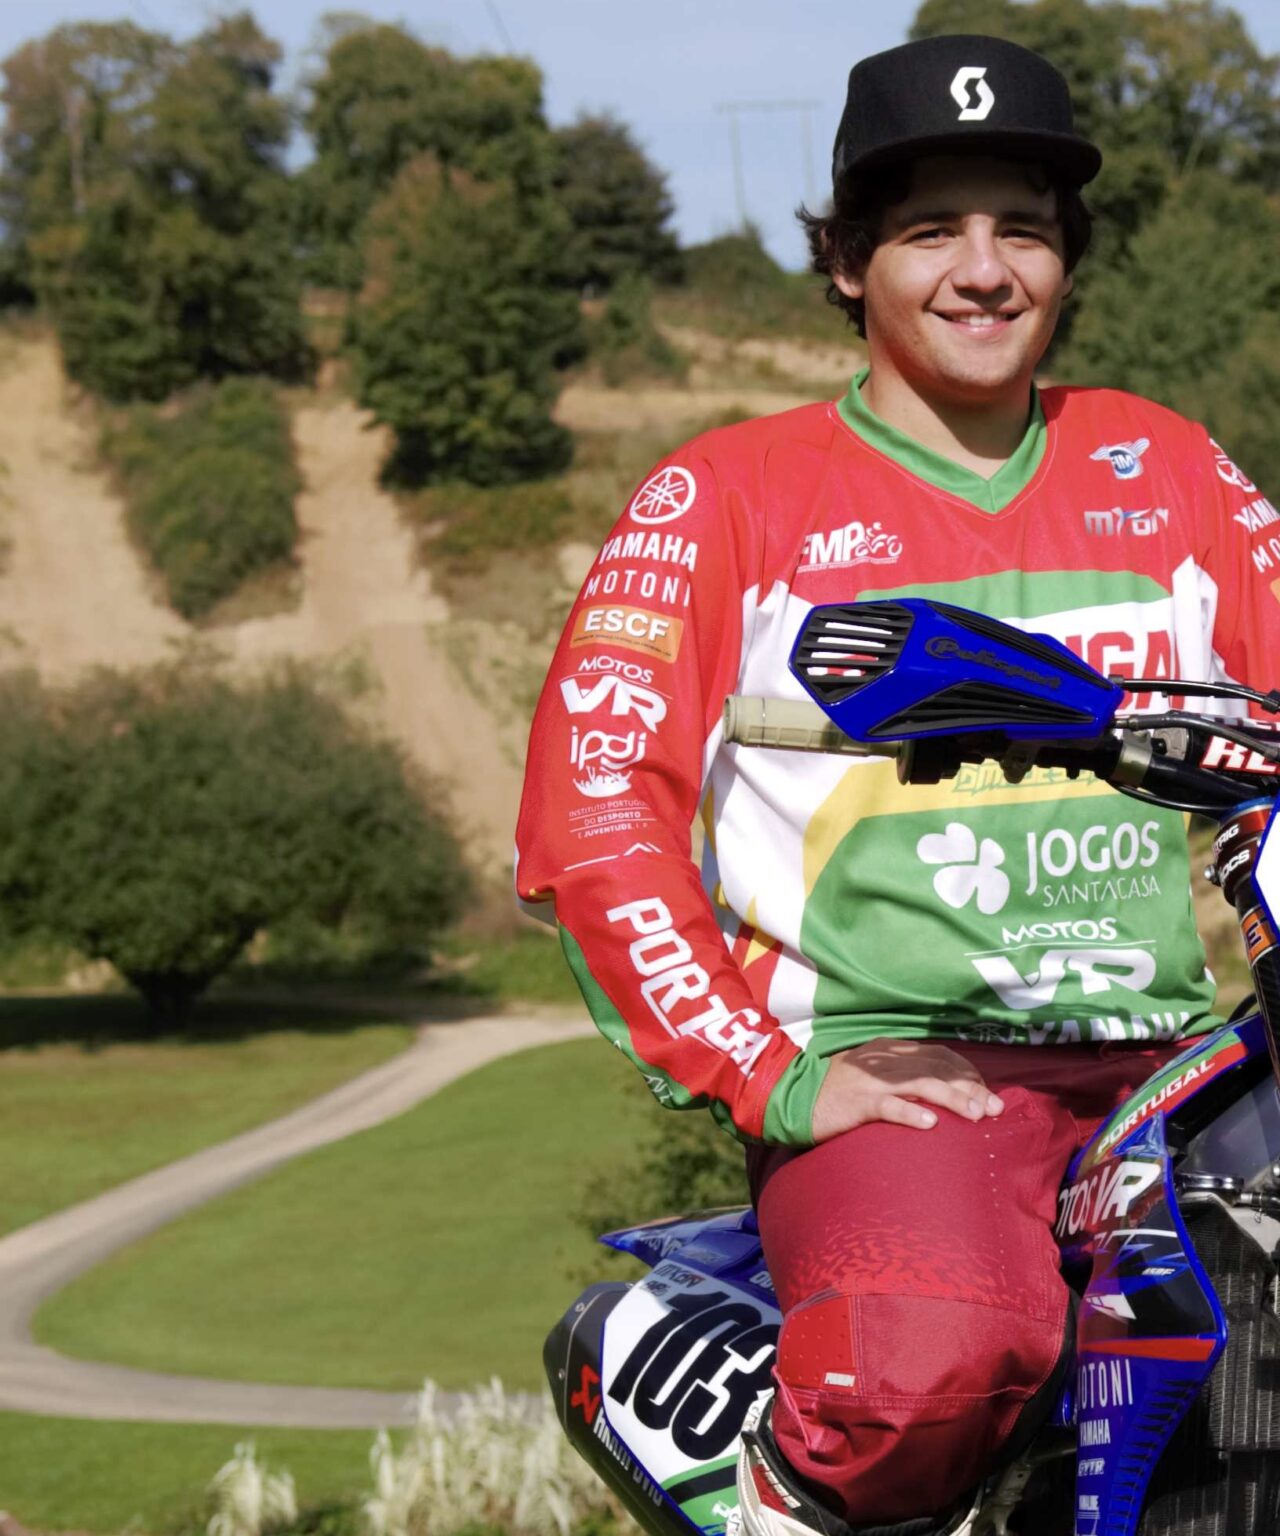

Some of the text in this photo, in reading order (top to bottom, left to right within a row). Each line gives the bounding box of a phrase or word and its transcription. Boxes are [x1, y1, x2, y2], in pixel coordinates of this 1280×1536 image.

[599, 532, 698, 572] YAMAHA
[583, 570, 690, 608] MOTONI
[584, 609, 669, 642] ESCF
[578, 655, 655, 684] MOTOS
[560, 675, 668, 734] VR
[1025, 821, 1161, 896] JOGOS
[1002, 917, 1119, 945] MOTOS
[1097, 1059, 1215, 1153] PORTUGAL
[607, 1291, 781, 1461] 103
